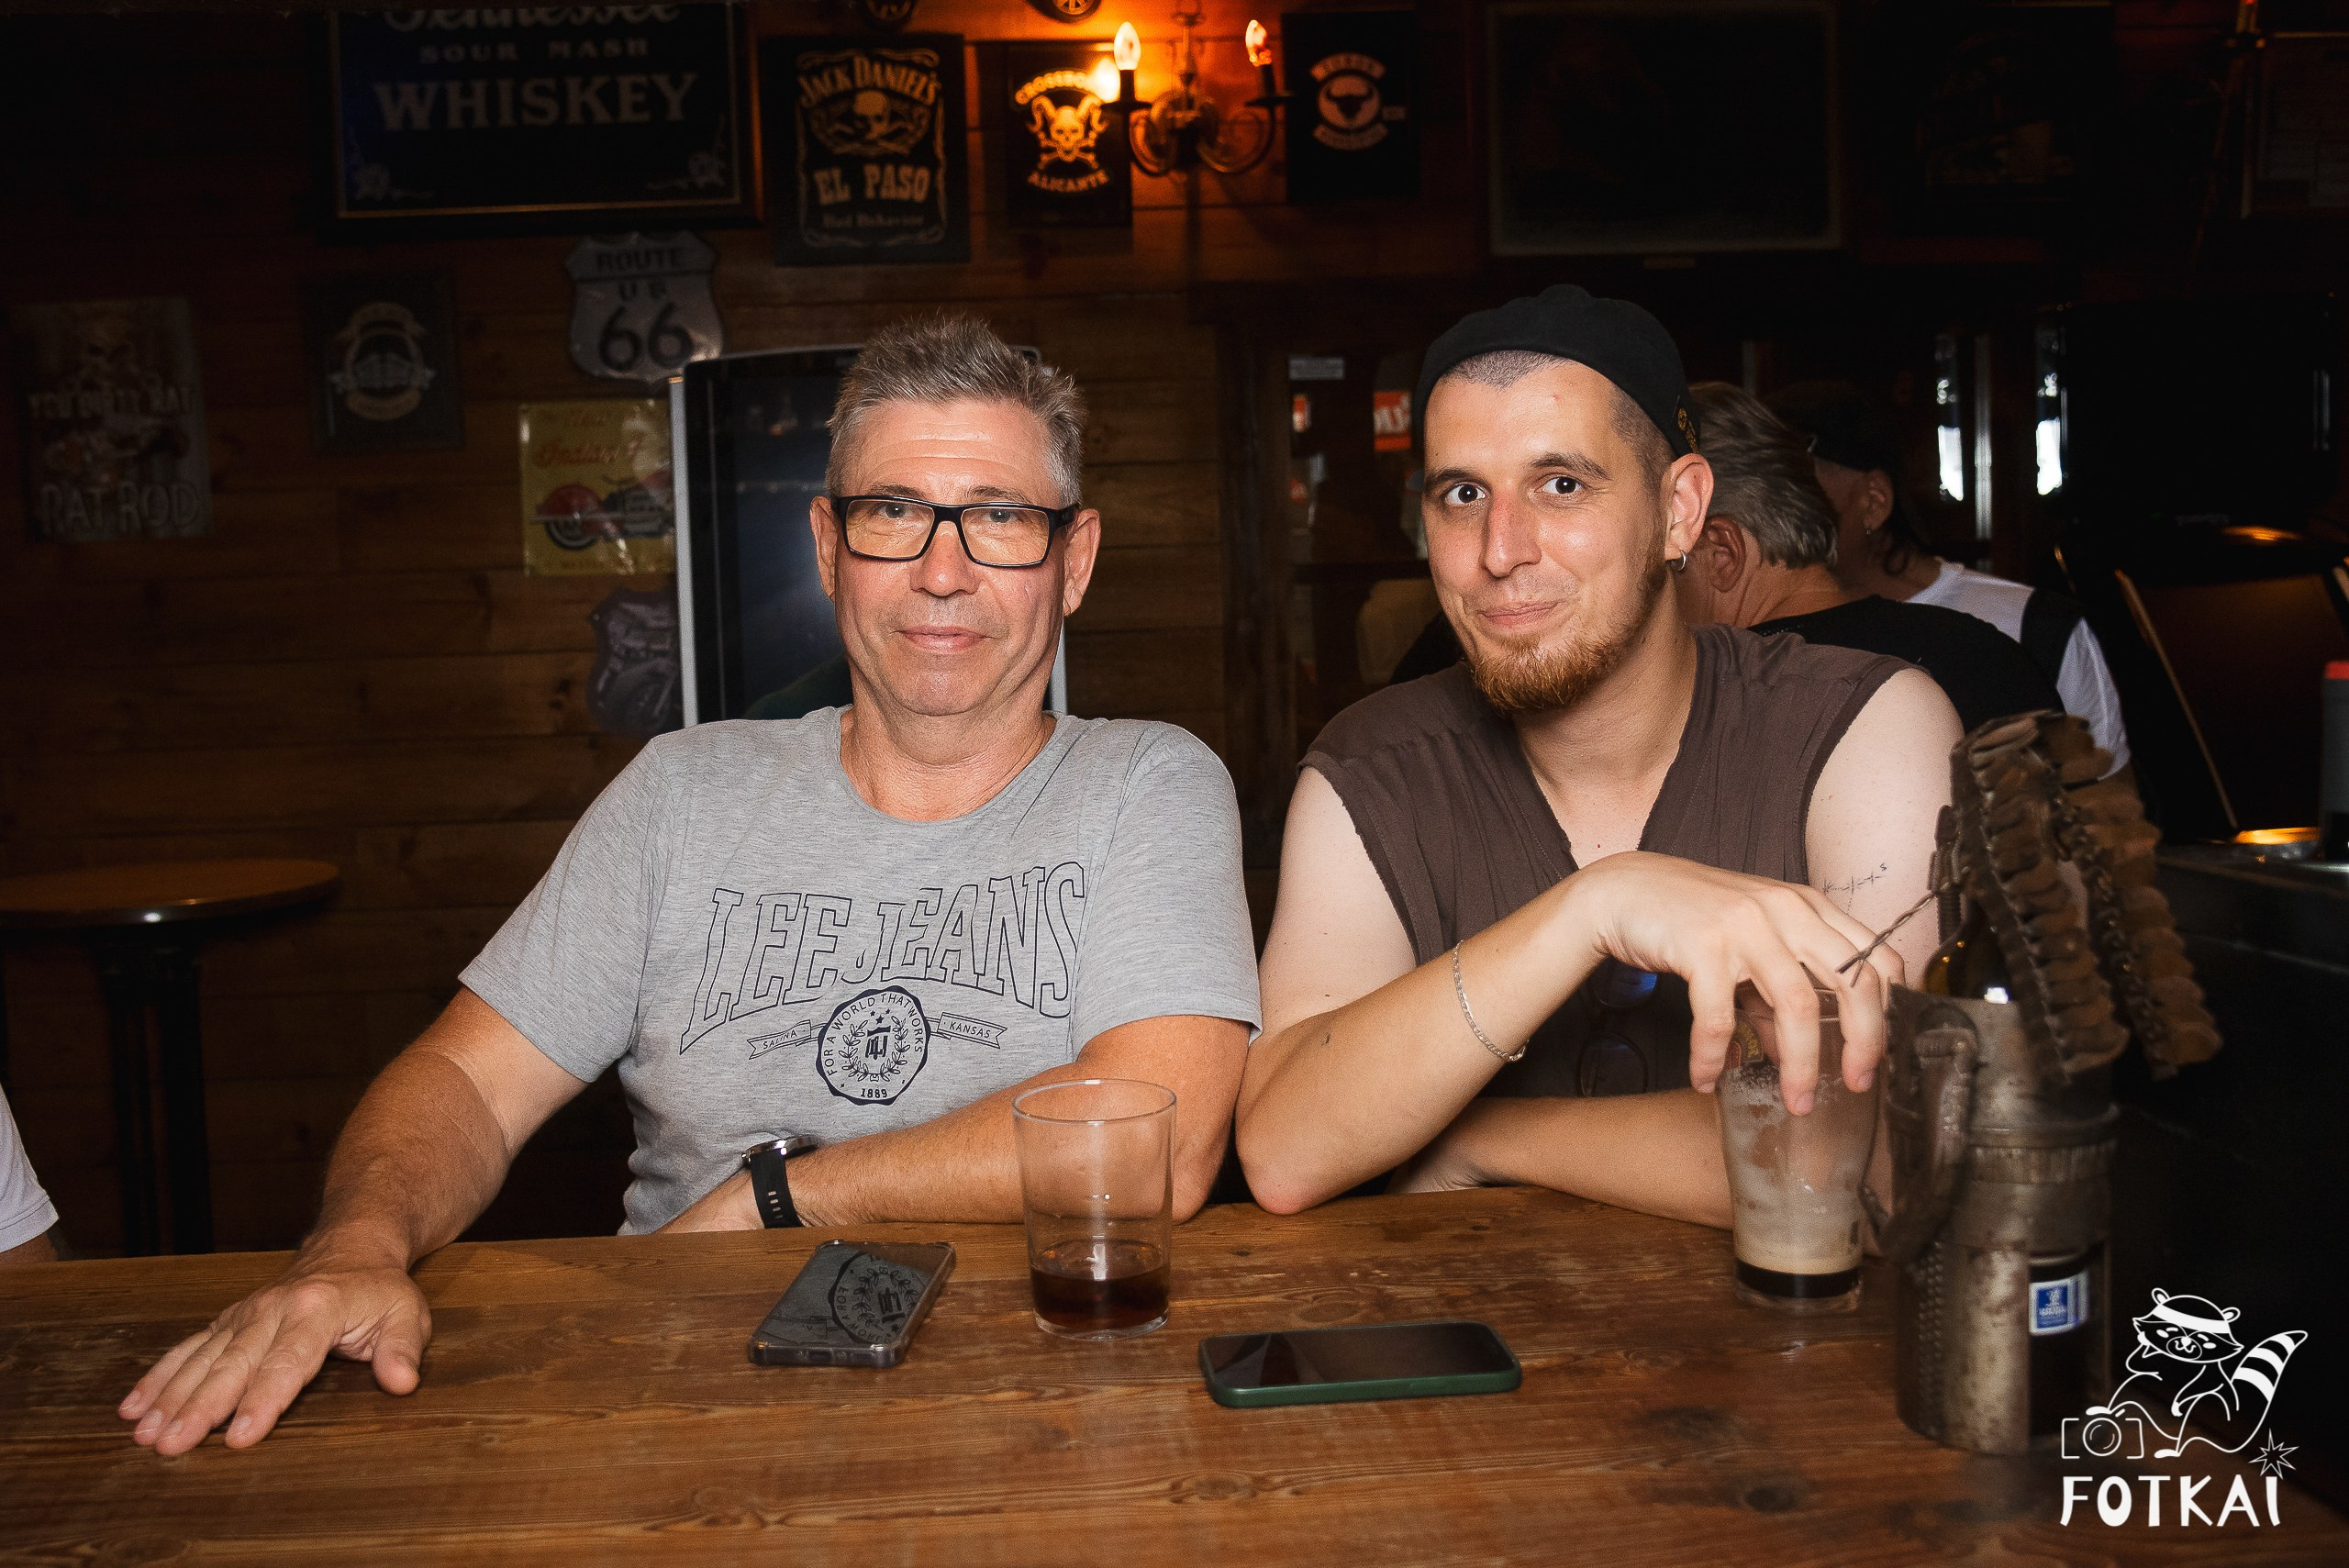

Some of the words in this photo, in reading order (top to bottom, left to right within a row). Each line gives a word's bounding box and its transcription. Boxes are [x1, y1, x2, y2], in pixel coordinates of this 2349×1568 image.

[419, 41, 519, 64] SOUR
[548, 37, 650, 60] MASH
[371, 72, 699, 132] WHISKEY
[813, 166, 852, 206] EL
[863, 162, 931, 204] PASO
[598, 249, 681, 271] ROUTE
[599, 302, 693, 371] 66
[40, 482, 107, 536] RAT
[117, 479, 199, 534] ROD
[680, 888, 852, 1055] LEE
[841, 862, 1085, 1018] JEANS
[831, 997, 875, 1030] WORLD
[880, 993, 912, 1009] THAT
[763, 1029, 797, 1050] SALINA
[827, 1036, 836, 1044] A
[907, 1006, 924, 1052] WORKS
[949, 1020, 991, 1039] KANSAS
[824, 1049, 838, 1076] FOR
[861, 1088, 888, 1098] 1889
